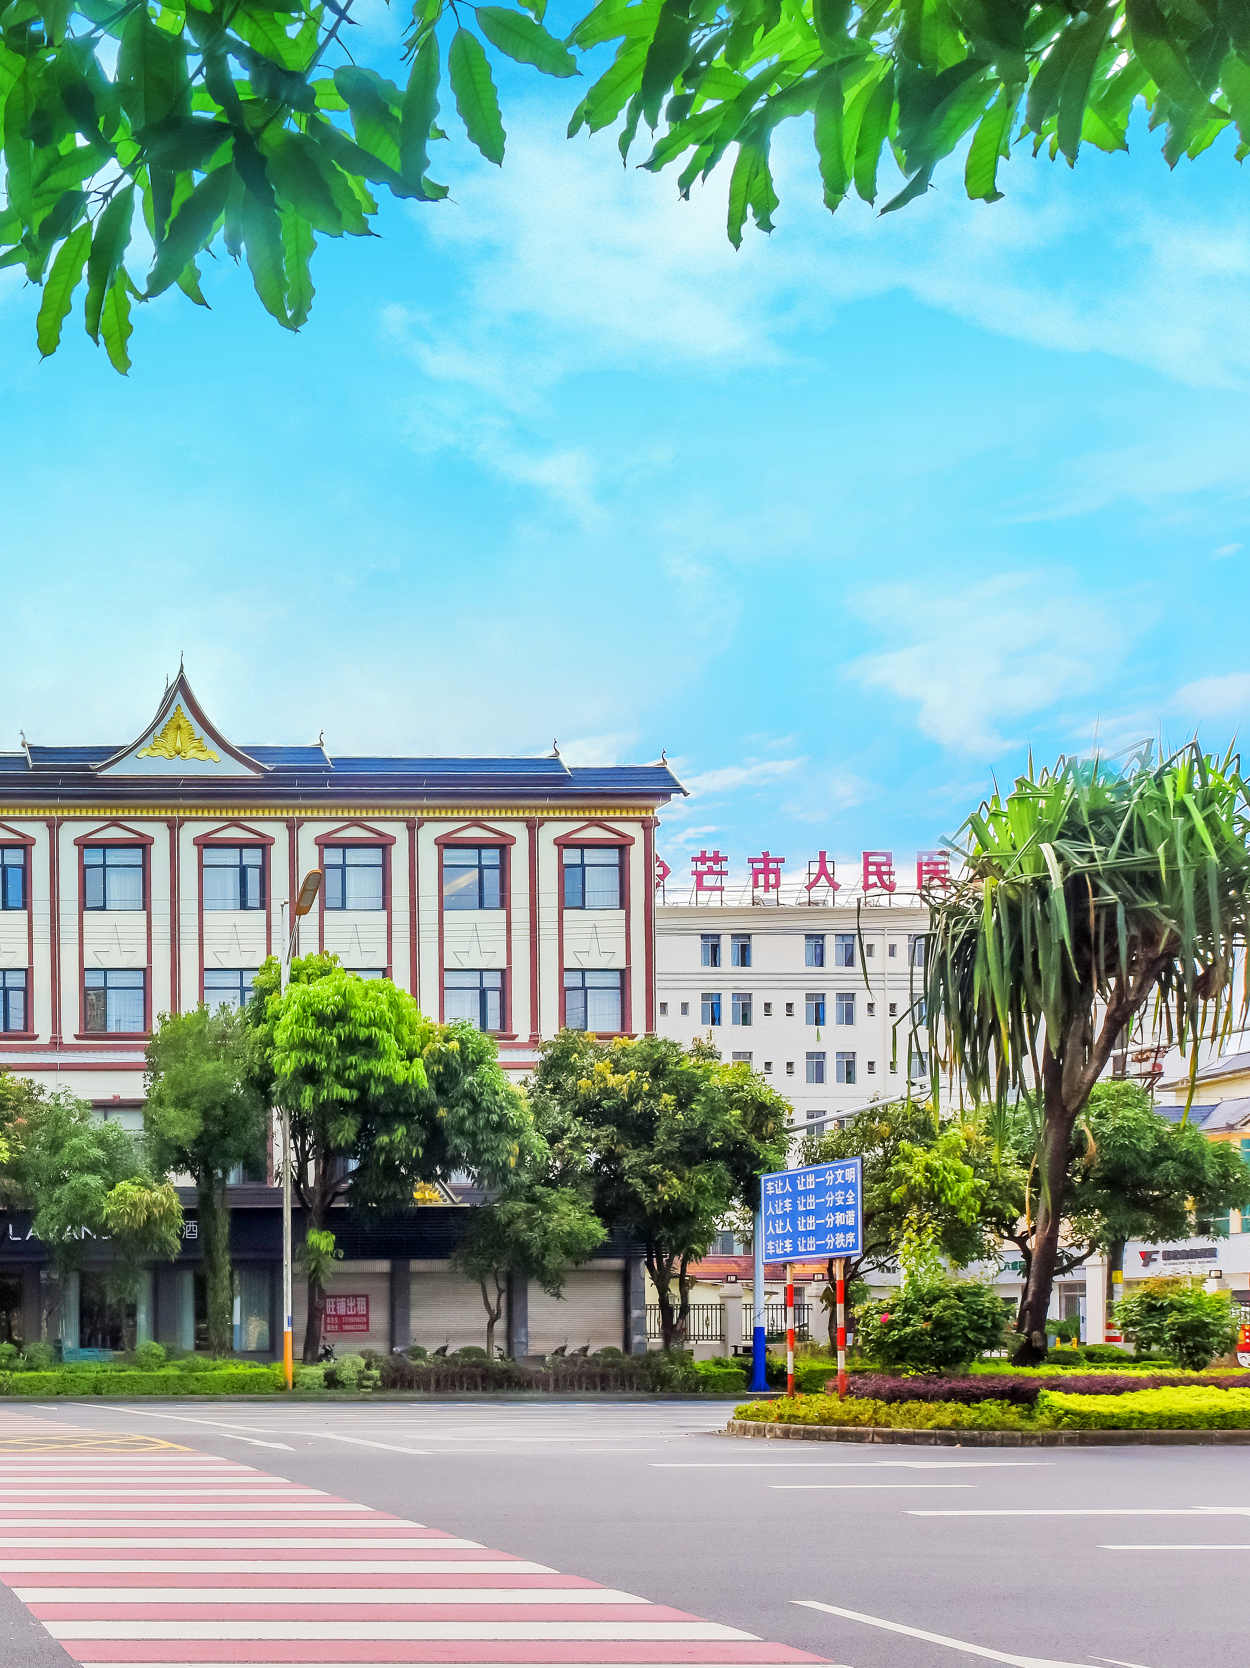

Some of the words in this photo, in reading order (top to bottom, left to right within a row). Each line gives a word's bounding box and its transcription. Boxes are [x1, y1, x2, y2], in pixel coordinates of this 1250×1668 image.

[765, 1178, 793, 1196] 车让人
[796, 1167, 856, 1191] 让出一分文明
[766, 1198, 793, 1216] 人让车
[796, 1188, 856, 1212] 让出一分安全
[766, 1218, 793, 1236] 人让人
[796, 1209, 856, 1232] 让出一分和谐
[766, 1238, 793, 1255] 车让车
[796, 1231, 856, 1252] 让出一分秩序
[326, 1297, 366, 1314] 旺铺出租
